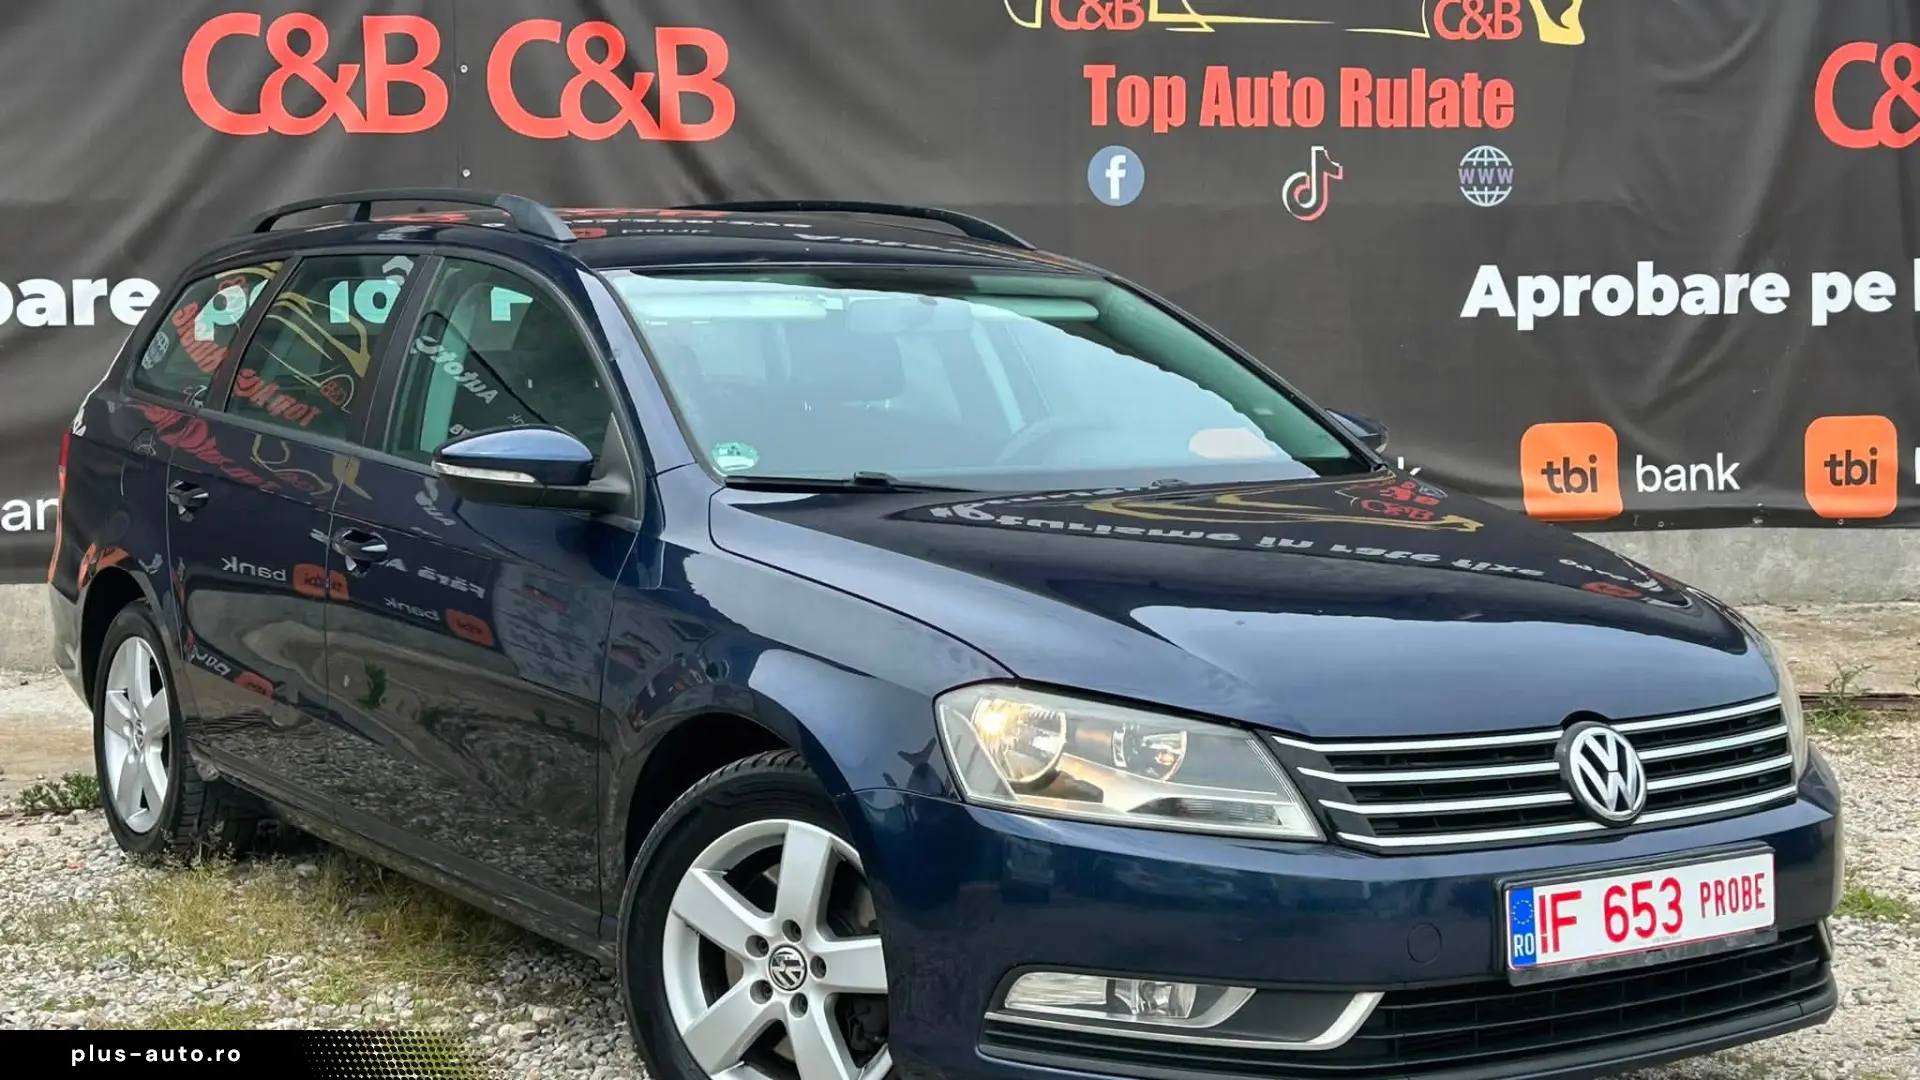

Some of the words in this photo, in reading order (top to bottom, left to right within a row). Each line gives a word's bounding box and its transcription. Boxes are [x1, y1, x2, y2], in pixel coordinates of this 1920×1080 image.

[1434, 0, 1523, 40] C&B
[182, 12, 448, 136] C&B
[487, 19, 735, 141] C&B
[1083, 64, 1187, 133] Top
[1199, 66, 1325, 128] Auto
[1340, 67, 1515, 130] Rulate
[1460, 261, 1790, 331] Aprobare
[1811, 271, 1896, 326] pe
[1541, 455, 1597, 493] tbi
[1636, 453, 1740, 493] bank
[1824, 447, 1877, 486] tbi
[1538, 890, 1582, 954] IF
[1603, 877, 1683, 943] 653
[1700, 873, 1765, 918] PROBE
[1513, 933, 1535, 957] RO
